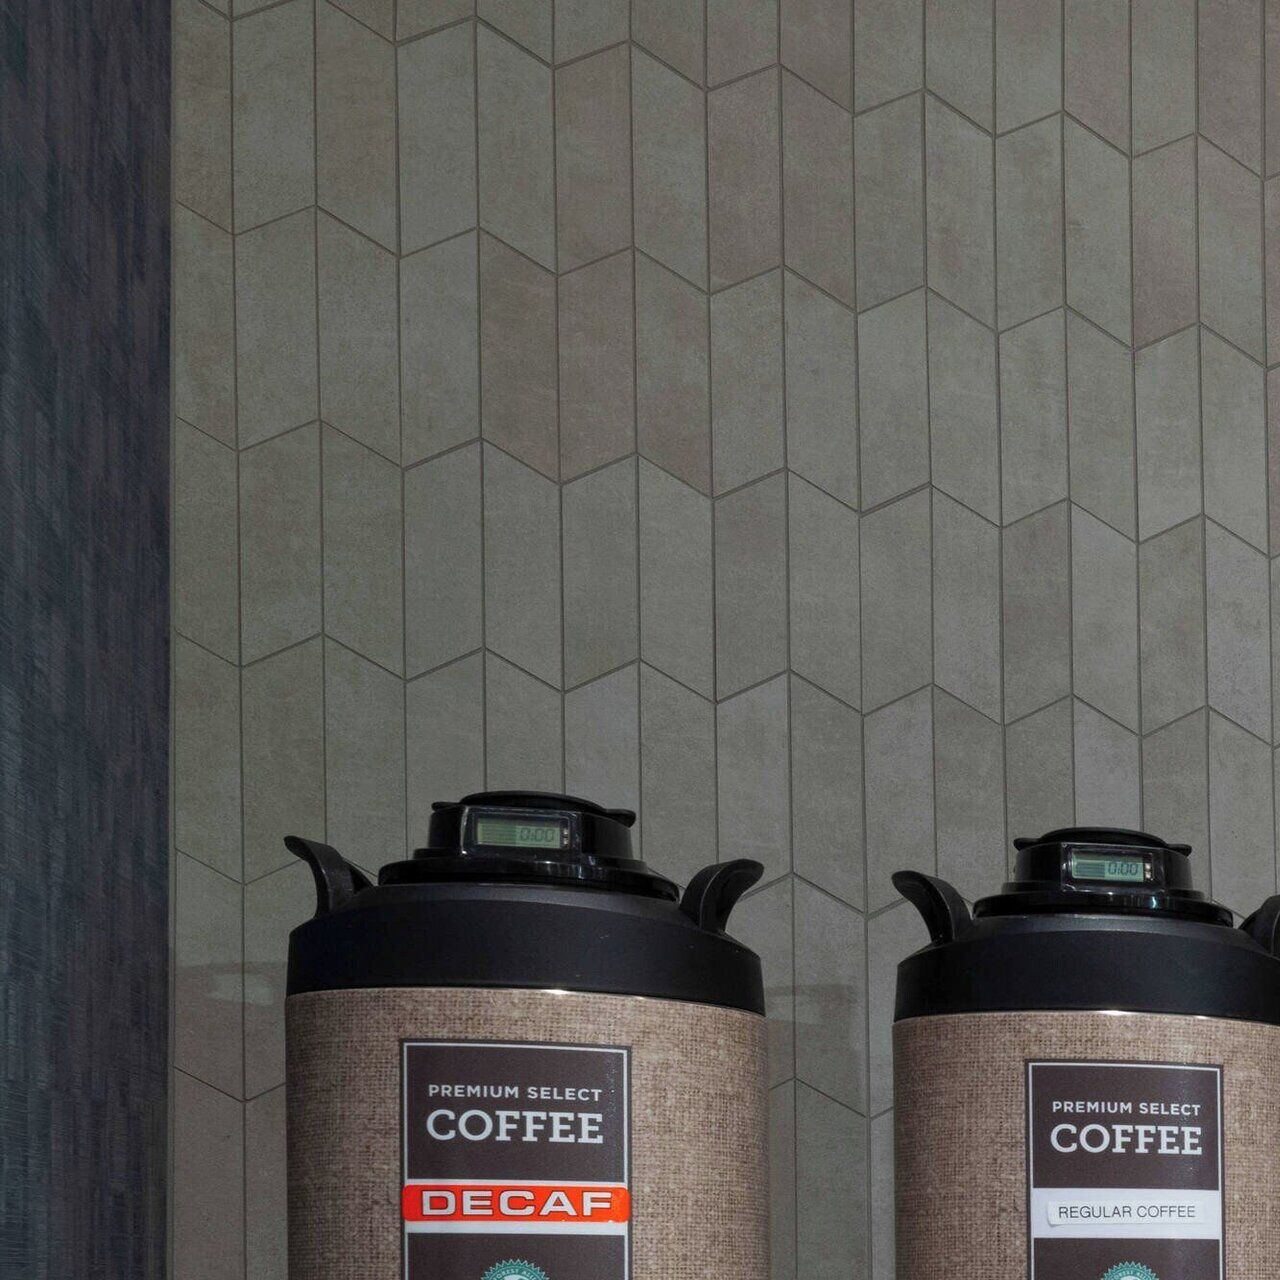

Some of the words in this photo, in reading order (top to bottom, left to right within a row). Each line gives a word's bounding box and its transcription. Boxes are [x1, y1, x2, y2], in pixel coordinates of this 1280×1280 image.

[428, 1084, 519, 1098] PREMIUM
[527, 1087, 602, 1101] SELECT
[1052, 1101, 1132, 1114] PREMIUM
[1139, 1102, 1202, 1116] SELECT
[426, 1109, 603, 1144] COFFEE
[1050, 1123, 1203, 1155] COFFEE
[422, 1190, 612, 1216] DECAF
[1058, 1205, 1132, 1218] REGULAR
[1136, 1205, 1196, 1218] COFFEE
